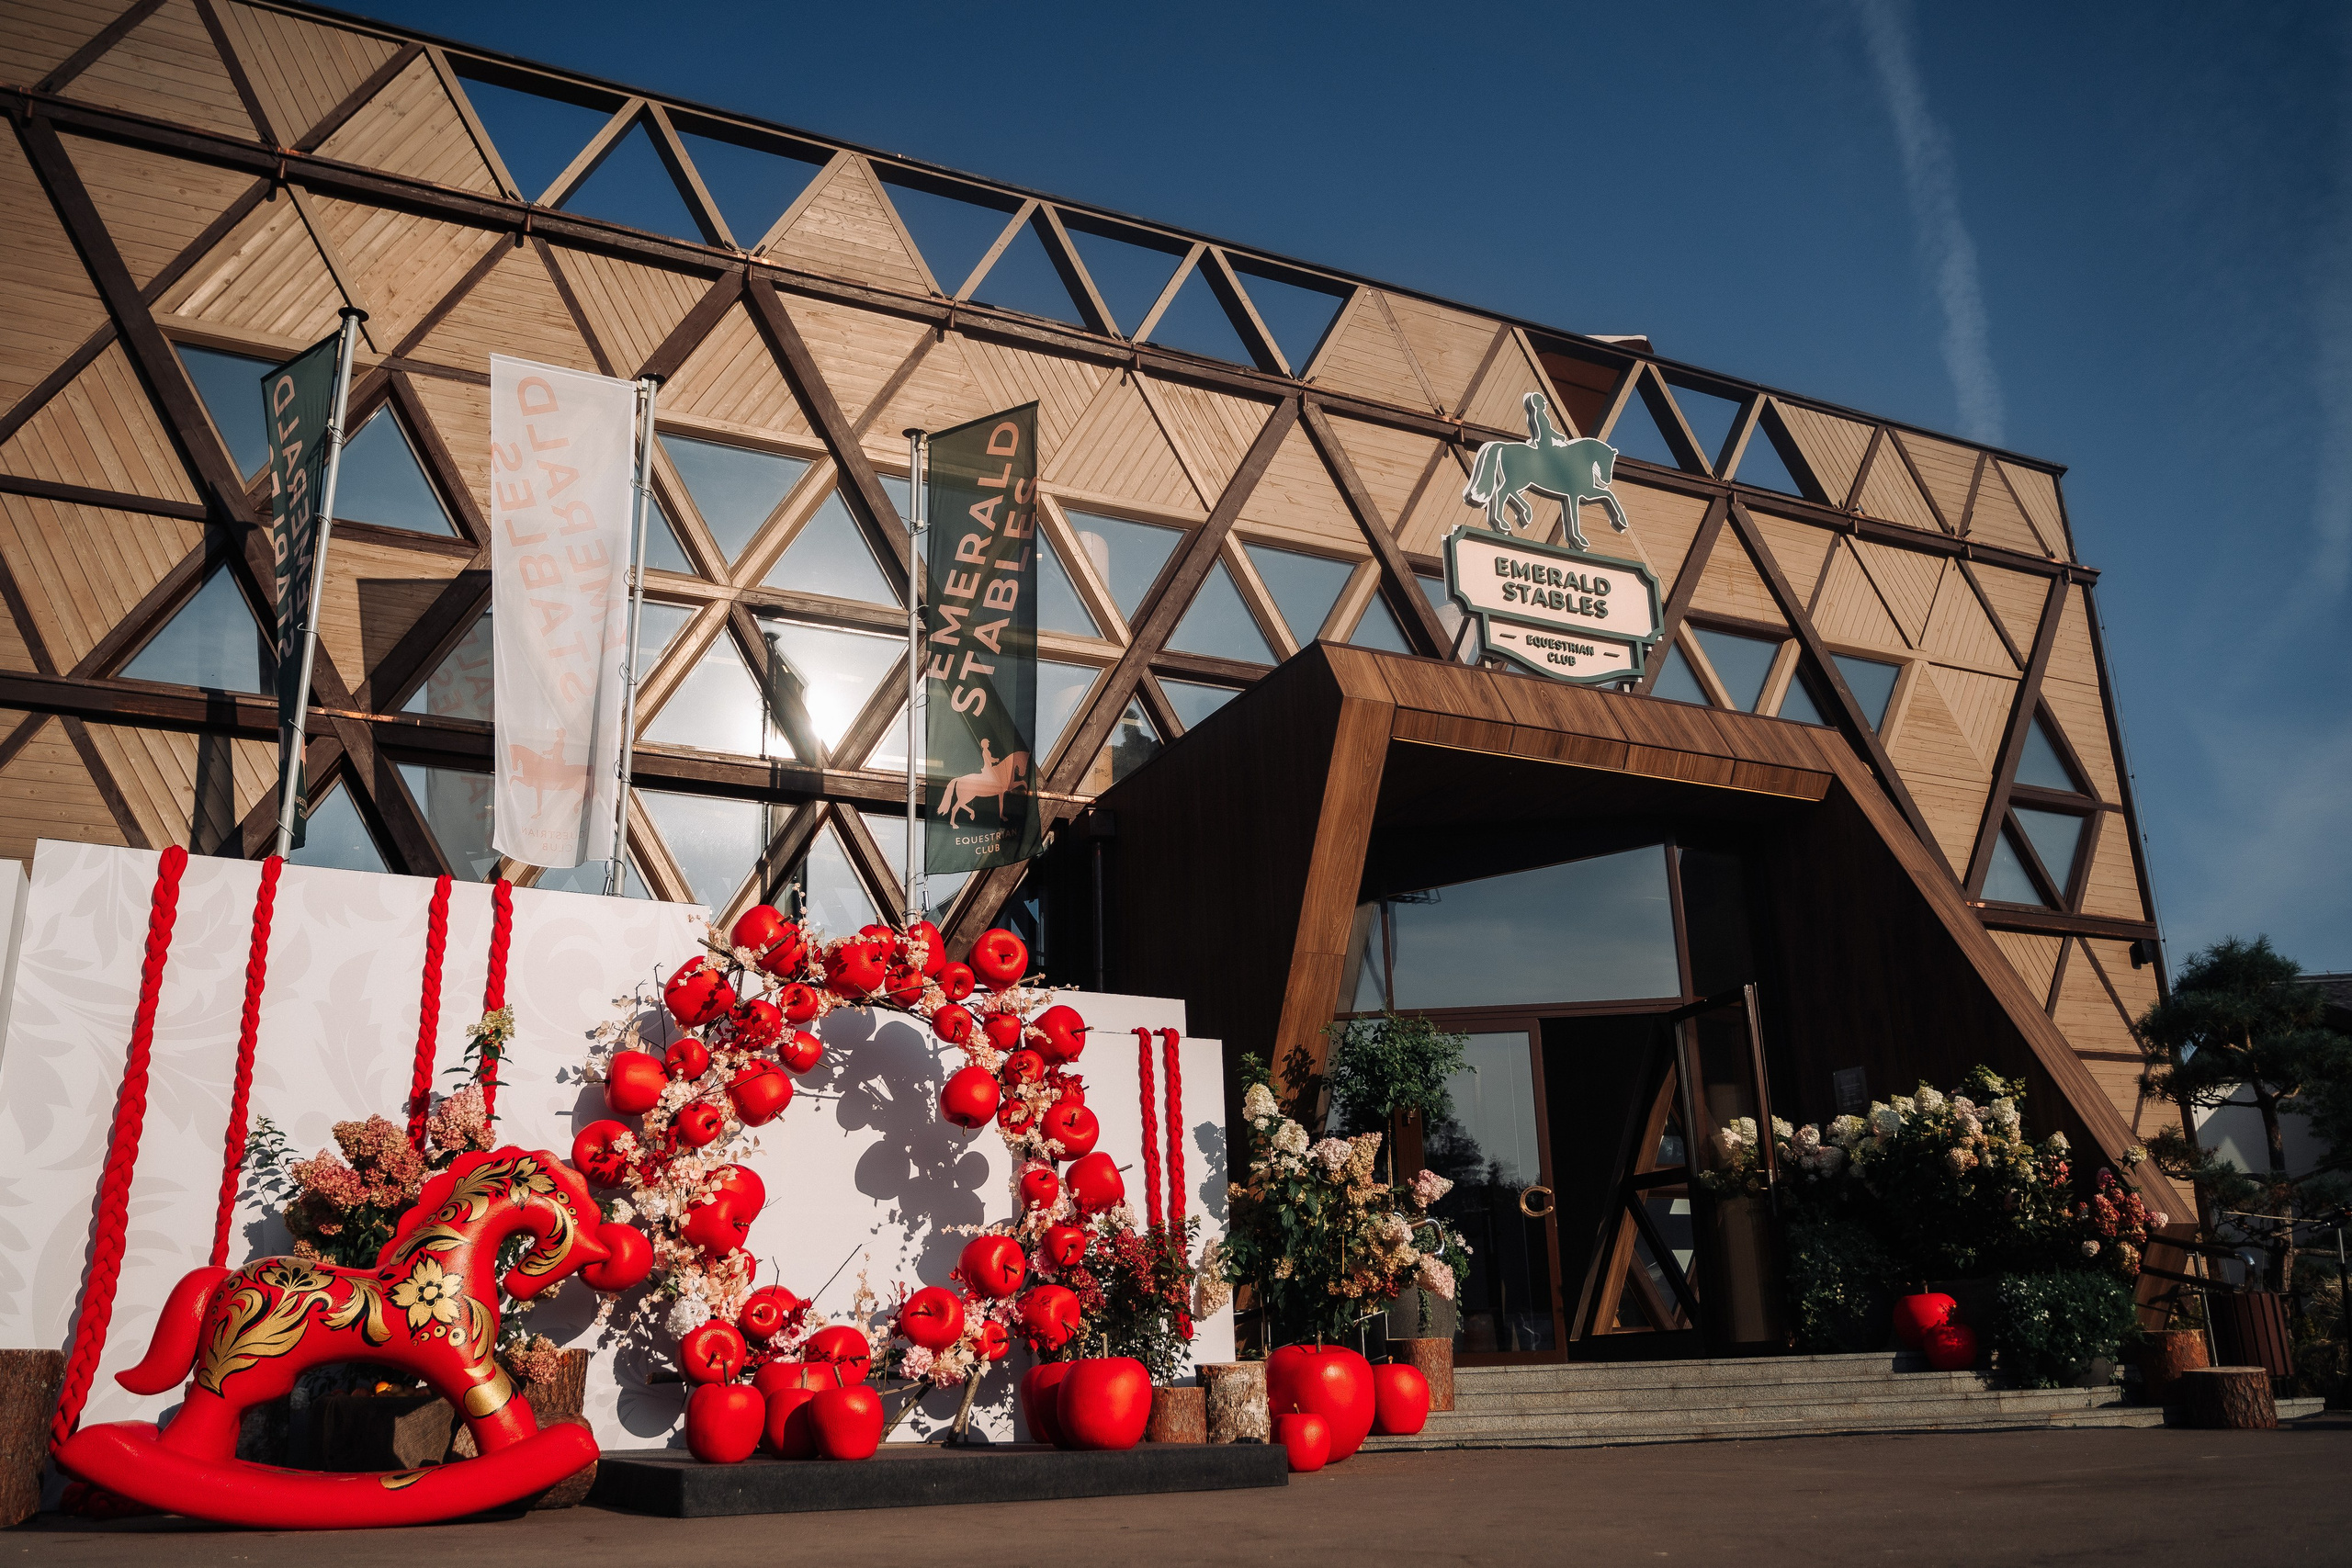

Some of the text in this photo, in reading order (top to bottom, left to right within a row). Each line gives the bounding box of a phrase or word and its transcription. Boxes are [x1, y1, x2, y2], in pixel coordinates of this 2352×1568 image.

[926, 422, 1020, 681] EMERALD
[1495, 556, 1611, 596] EMERALD
[951, 476, 1038, 717] STABLES
[1502, 581, 1609, 618] STABLES
[1526, 635, 1594, 656] EQUESTRIAN
[1547, 652, 1577, 666] CLUB
[955, 828, 1018, 845] EQUESTRIAN
[975, 843, 1001, 855] CLUB
